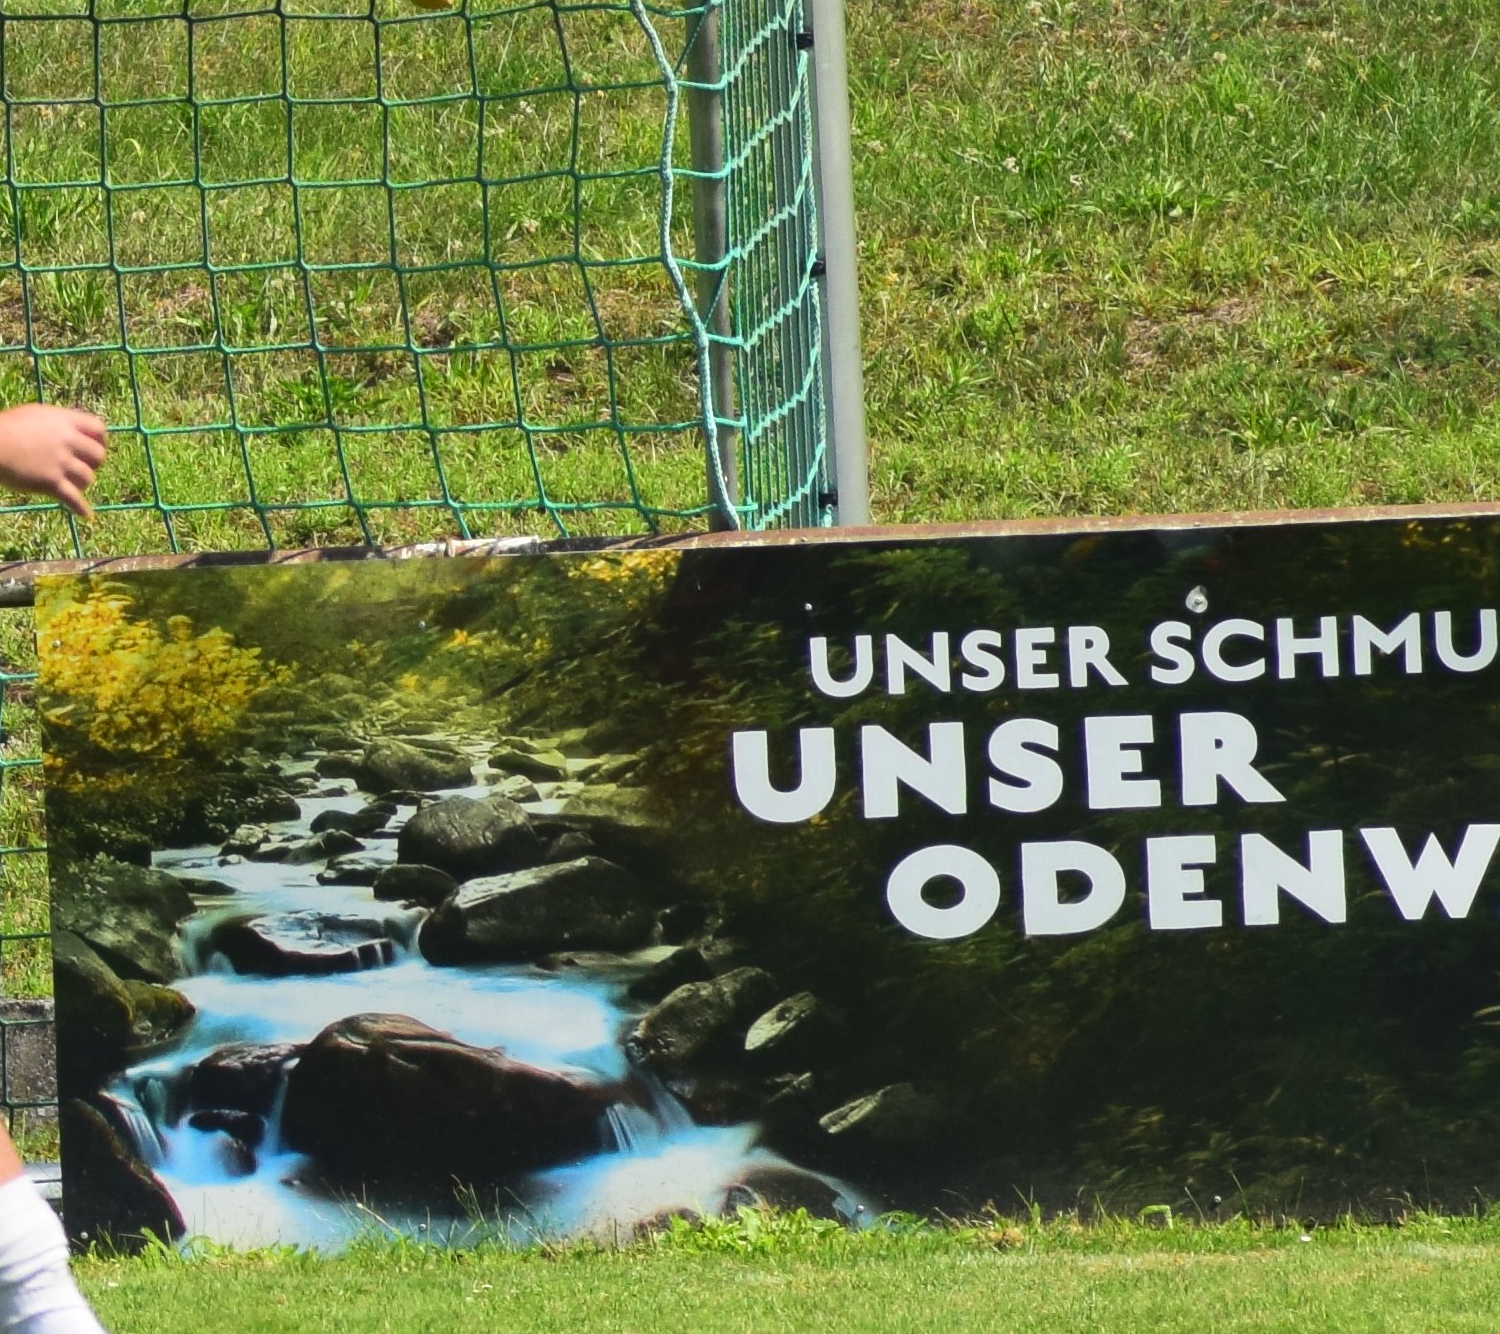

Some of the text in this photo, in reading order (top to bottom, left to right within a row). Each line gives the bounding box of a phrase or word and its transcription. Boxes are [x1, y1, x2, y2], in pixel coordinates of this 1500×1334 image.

[809, 608, 1498, 698] UNSER SCHMU
[732, 711, 1287, 823] UNSER
[886, 823, 1500, 940] ODENW
